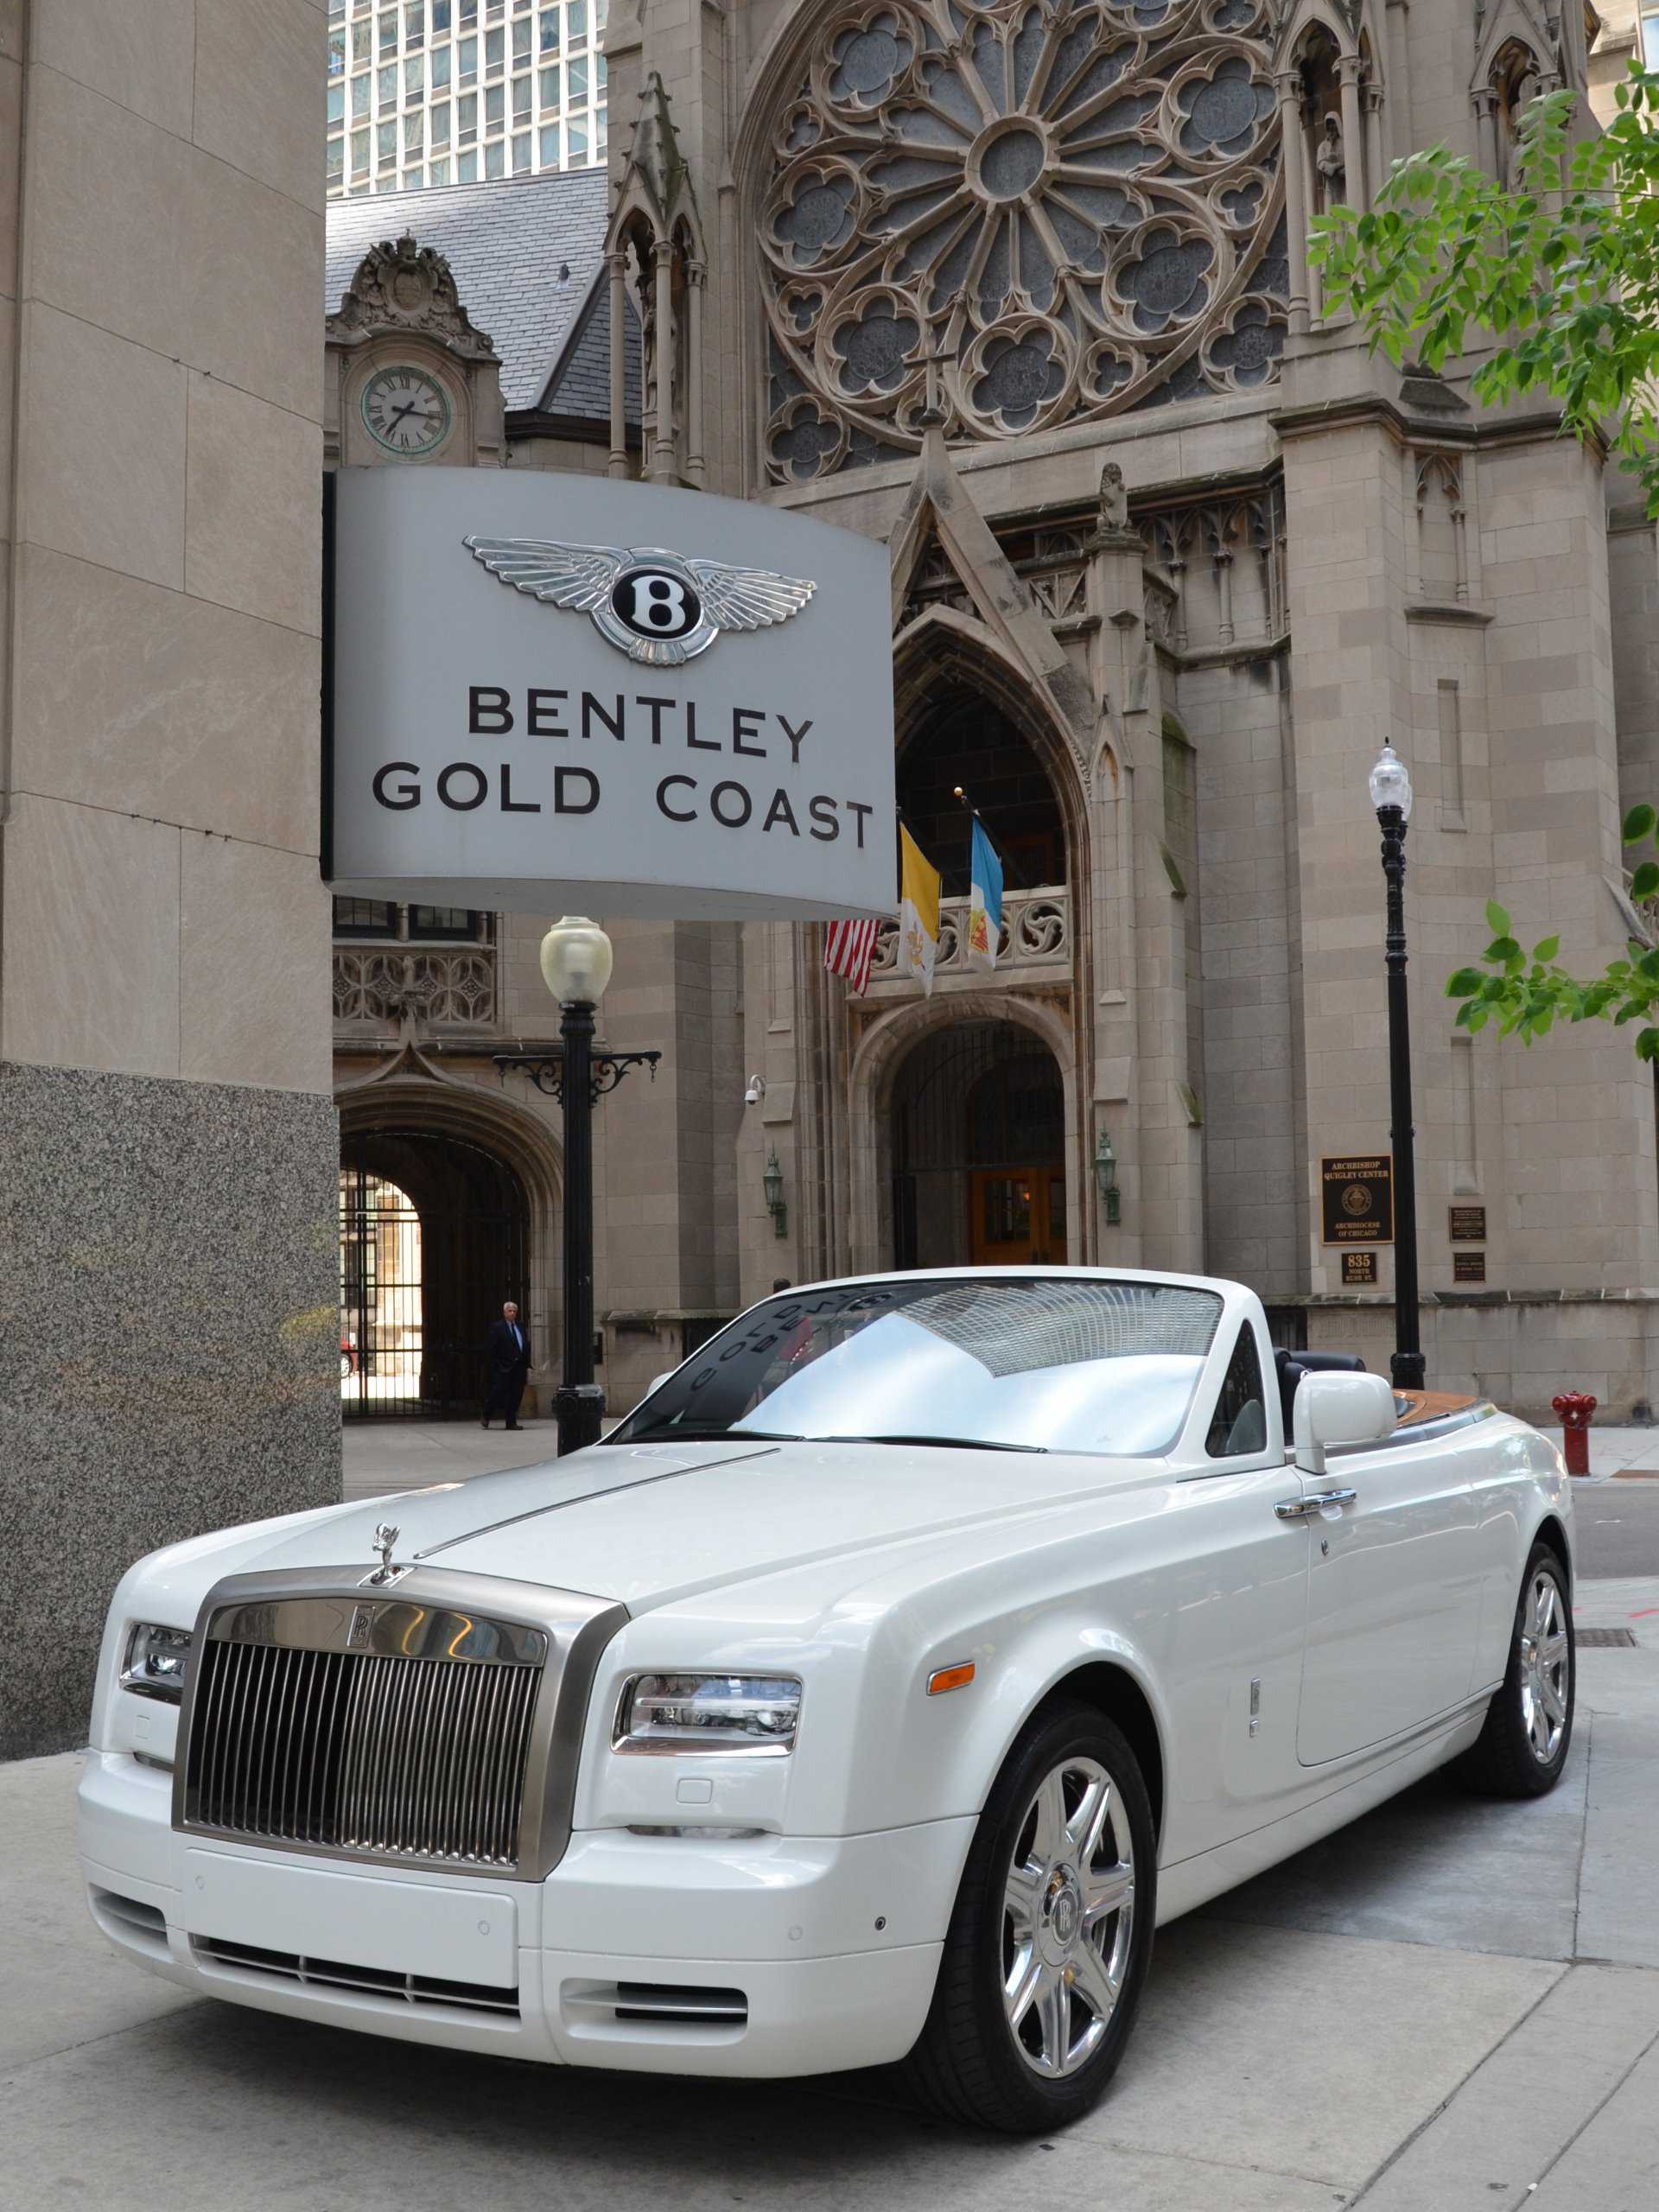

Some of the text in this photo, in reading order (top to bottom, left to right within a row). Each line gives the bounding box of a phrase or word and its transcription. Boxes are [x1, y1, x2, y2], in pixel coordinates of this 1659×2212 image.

[631, 575, 685, 632] B
[468, 685, 814, 764] BENTLEY
[372, 761, 874, 849] GOLD COAST
[1324, 1170, 1389, 1180] QUIGLEY CENTER
[1332, 1161, 1381, 1170] ARCHBISHOP
[1348, 1254, 1370, 1268] 835
